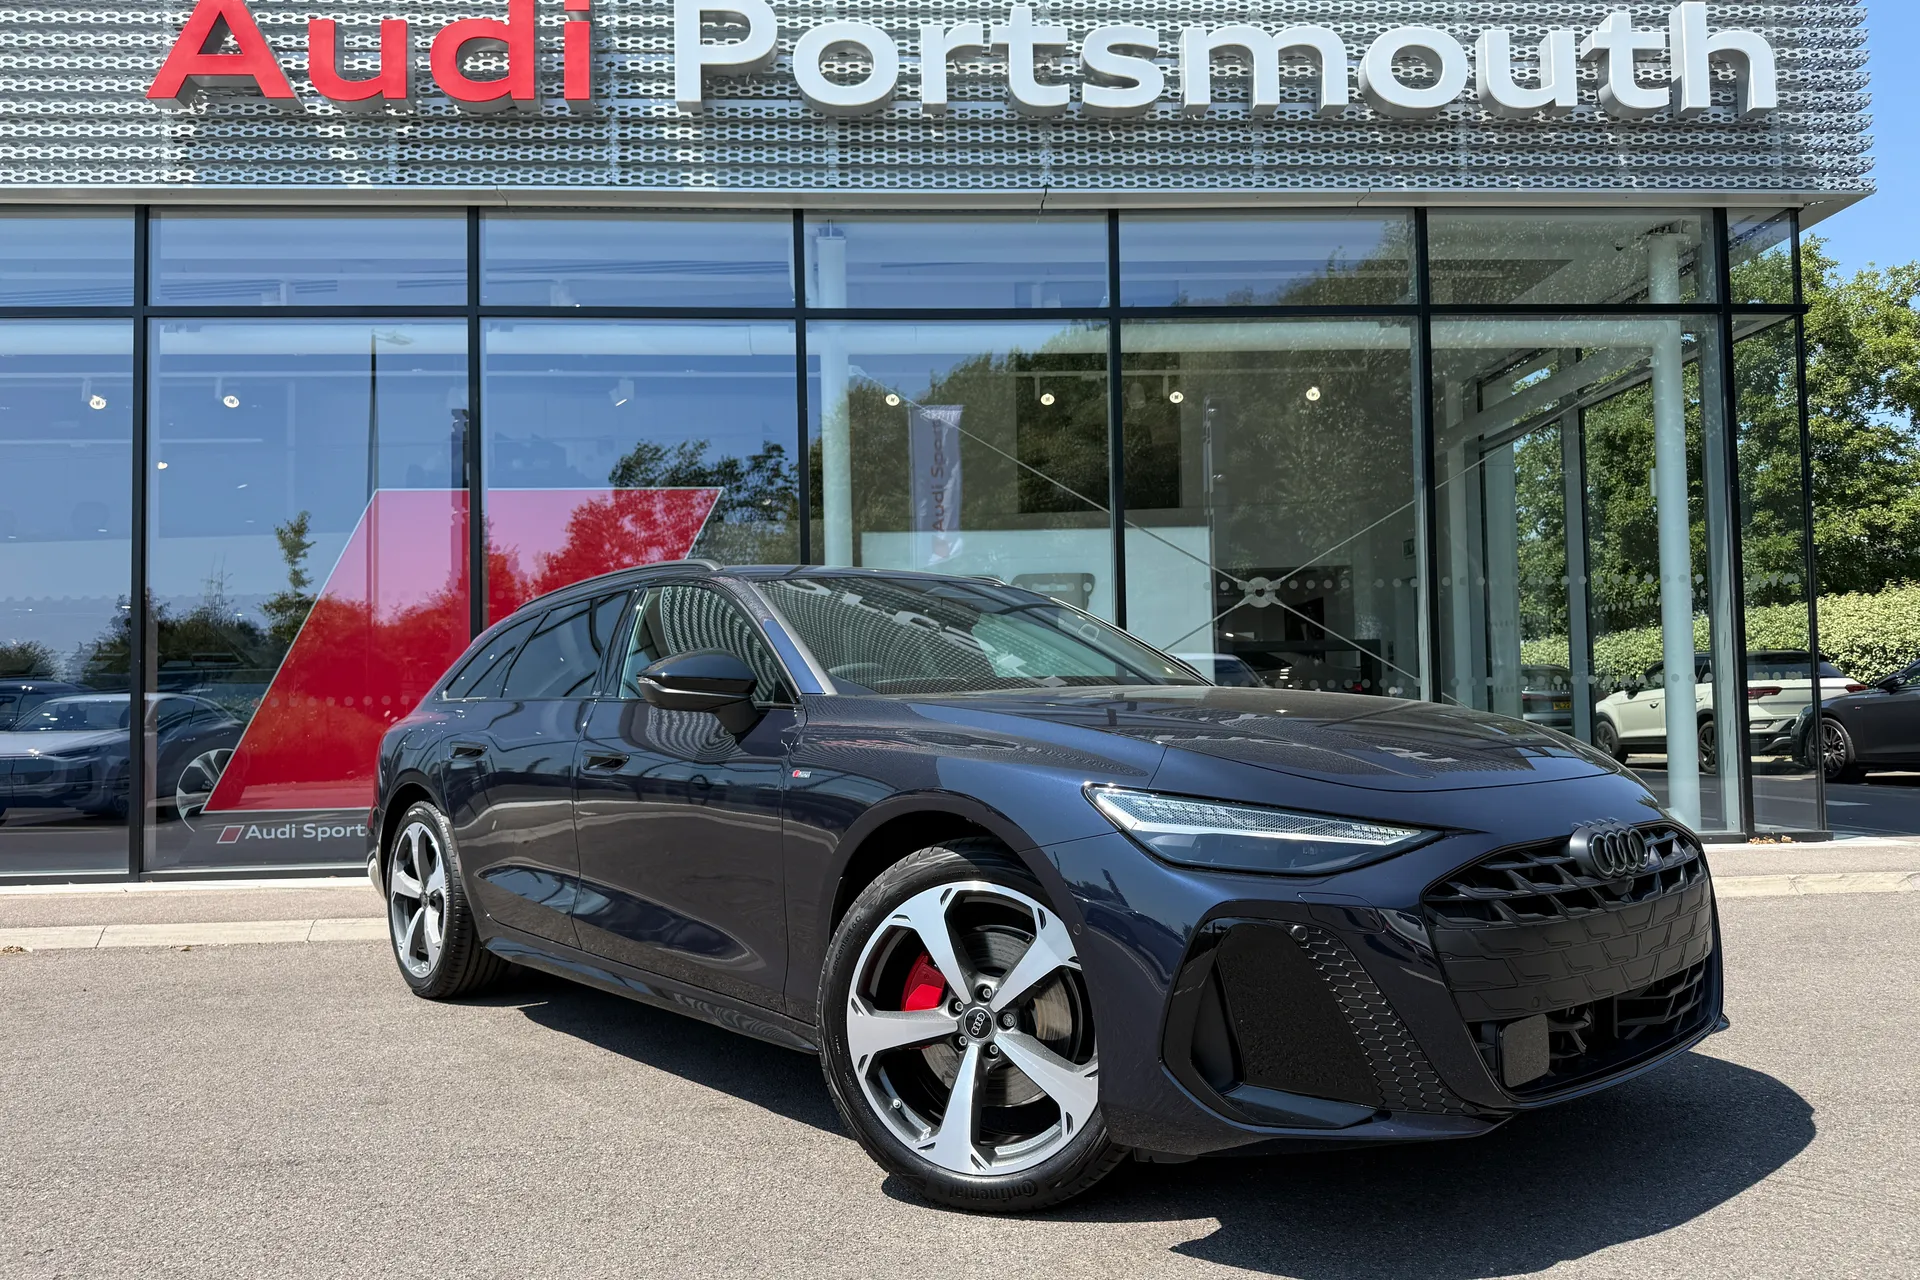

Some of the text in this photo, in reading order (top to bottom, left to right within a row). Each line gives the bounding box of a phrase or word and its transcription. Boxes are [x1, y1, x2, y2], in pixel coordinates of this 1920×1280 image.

[146, 0, 1777, 110] Audi Portsmouth
[932, 484, 945, 532] Audi
[245, 823, 366, 842] Audi Sport
[949, 1178, 1039, 1201] Continental
